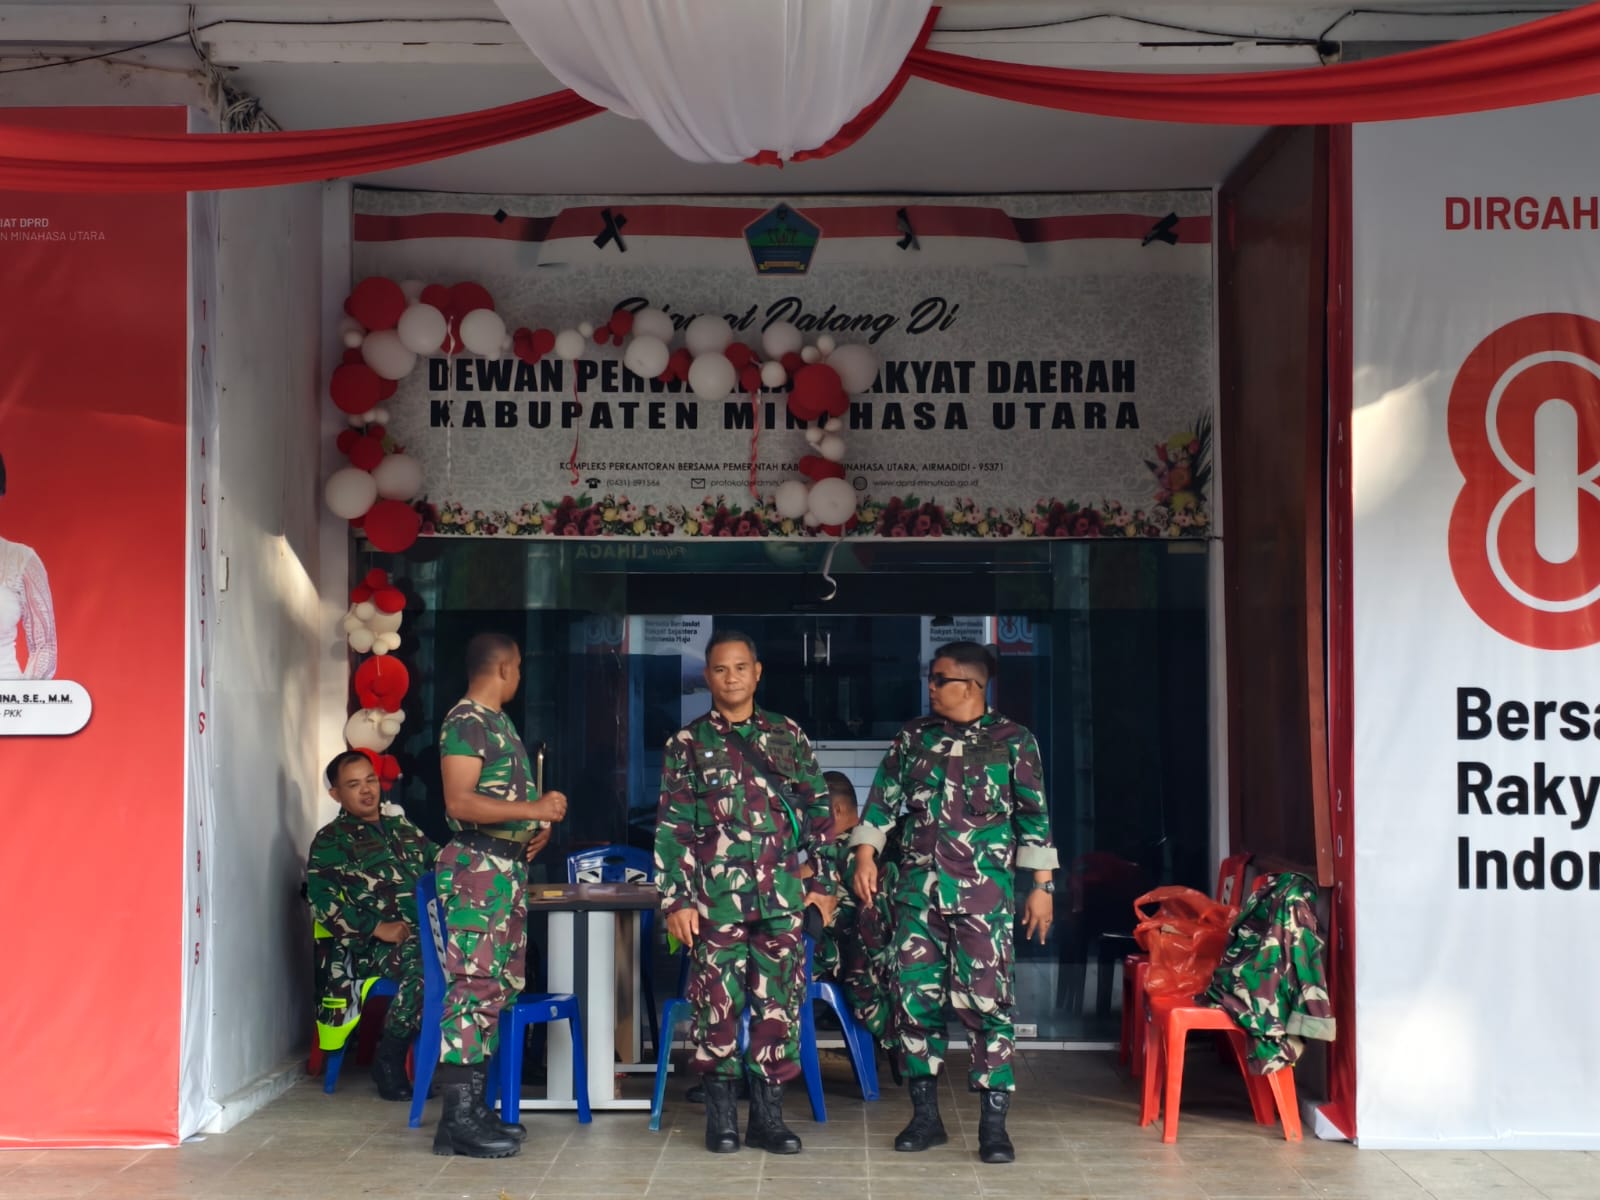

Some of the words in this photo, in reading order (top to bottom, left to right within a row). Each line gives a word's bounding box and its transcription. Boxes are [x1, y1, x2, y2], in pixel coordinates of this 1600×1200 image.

[20, 217, 49, 228] DPRD
[1445, 196, 1599, 230] DIRGAH
[10, 231, 66, 241] MINAHASA
[69, 231, 105, 241] UTARA
[906, 296, 960, 335] Di
[429, 358, 564, 392] DEWAN
[860, 360, 976, 394] AKYAT
[988, 359, 1136, 394] DAERAH
[430, 400, 698, 430] KABUPATEN
[724, 400, 969, 431] MINHASA
[993, 401, 1140, 430] UTARA
[559, 462, 607, 471] KOMPLEKS
[609, 462, 675, 472] PERKANTORAN
[678, 462, 720, 472] BERSAMA
[723, 462, 778, 472] PEMERNTAH
[887, 463, 919, 473] UTARA,
[921, 463, 970, 472] AIRMADIDI
[978, 463, 1004, 472] 95371
[22, 694, 46, 704] S.E.,
[48, 694, 73, 703] M.M.
[3, 709, 23, 718] PKK
[1457, 687, 1600, 741] Bers
